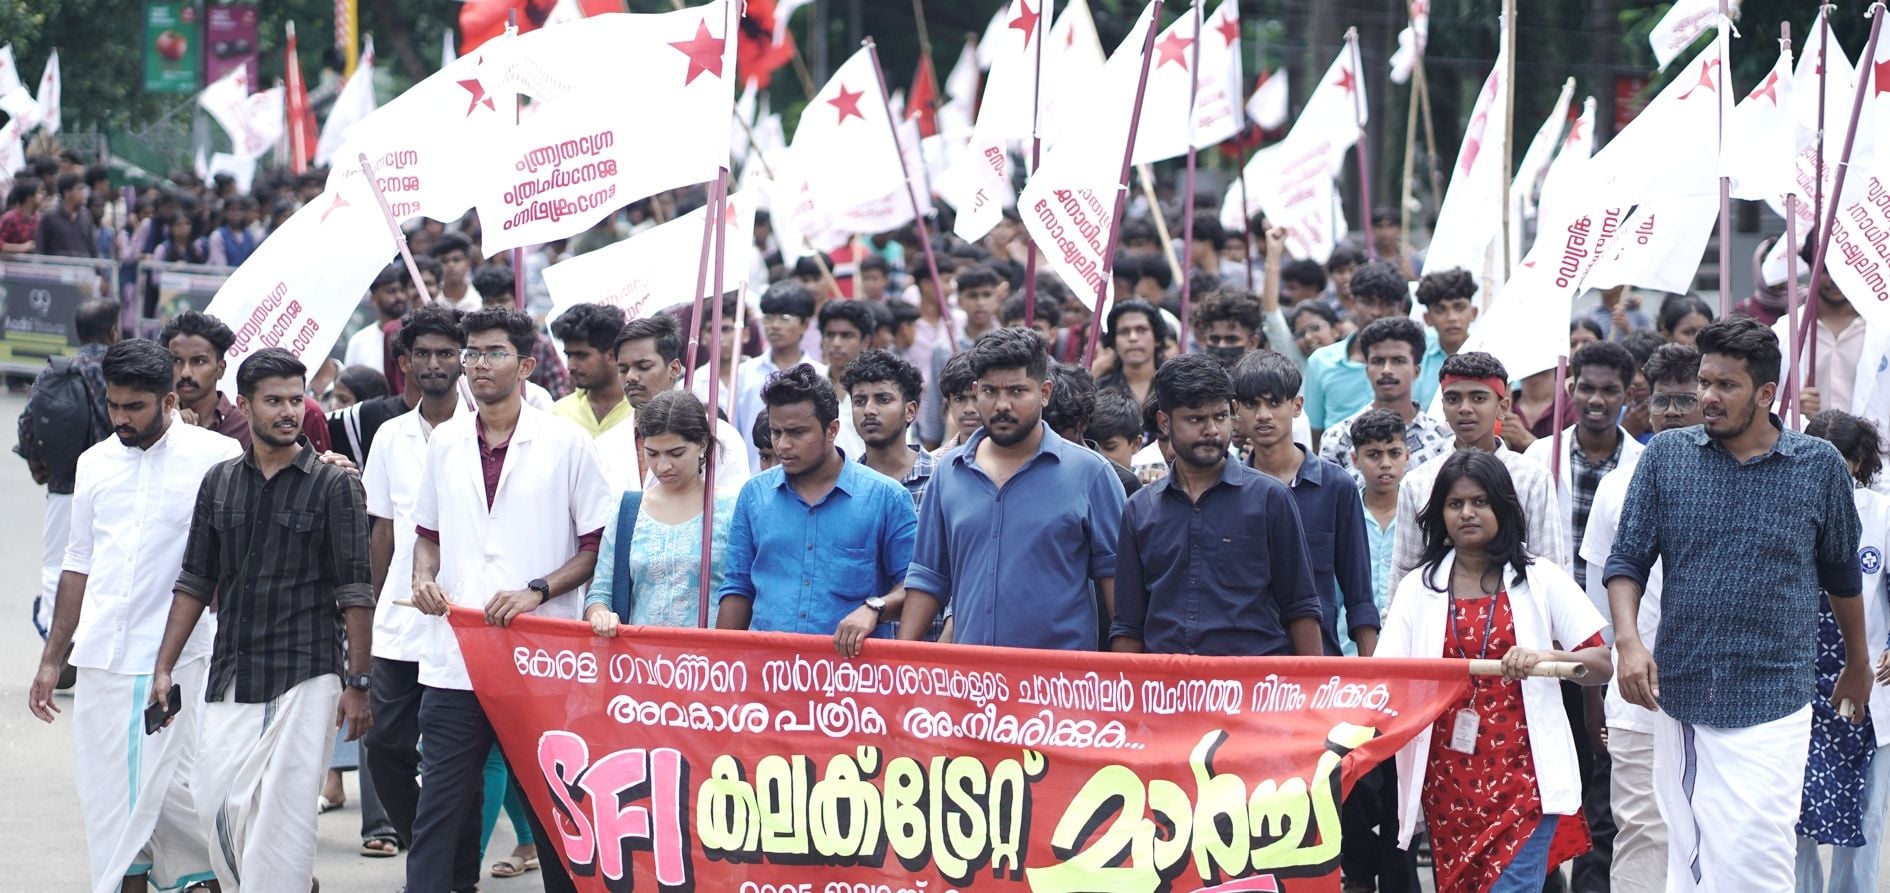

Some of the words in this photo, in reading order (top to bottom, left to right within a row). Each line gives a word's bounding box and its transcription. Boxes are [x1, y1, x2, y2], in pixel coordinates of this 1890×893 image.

[1034, 198, 1104, 298] സോഷ്യലിസ
[513, 646, 598, 684] കേരള
[1250, 672, 1306, 713] നിന്നും
[537, 729, 690, 887] SFI
